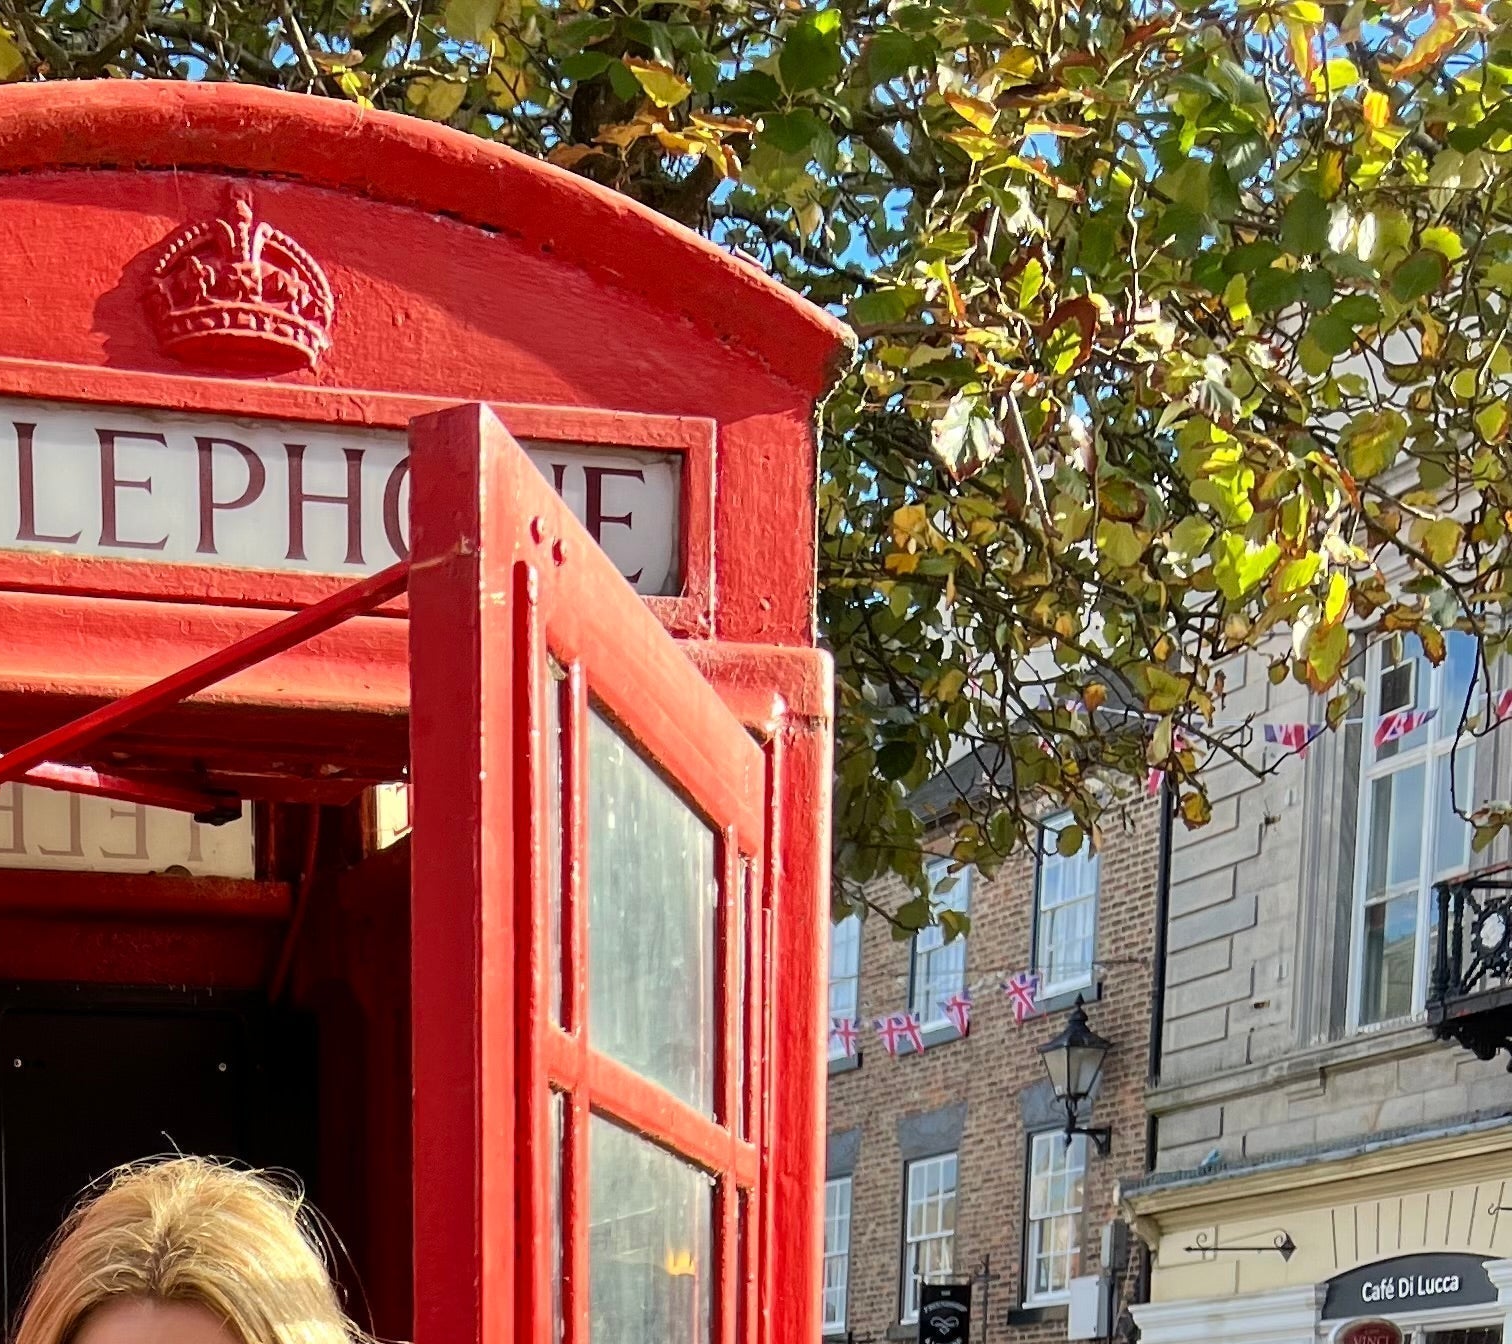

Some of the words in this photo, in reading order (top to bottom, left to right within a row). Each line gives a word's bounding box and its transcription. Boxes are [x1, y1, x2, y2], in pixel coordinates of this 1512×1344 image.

[1361, 1276, 1395, 1303] Café
[1398, 1277, 1414, 1299] Di
[1417, 1274, 1460, 1296] Lucca
